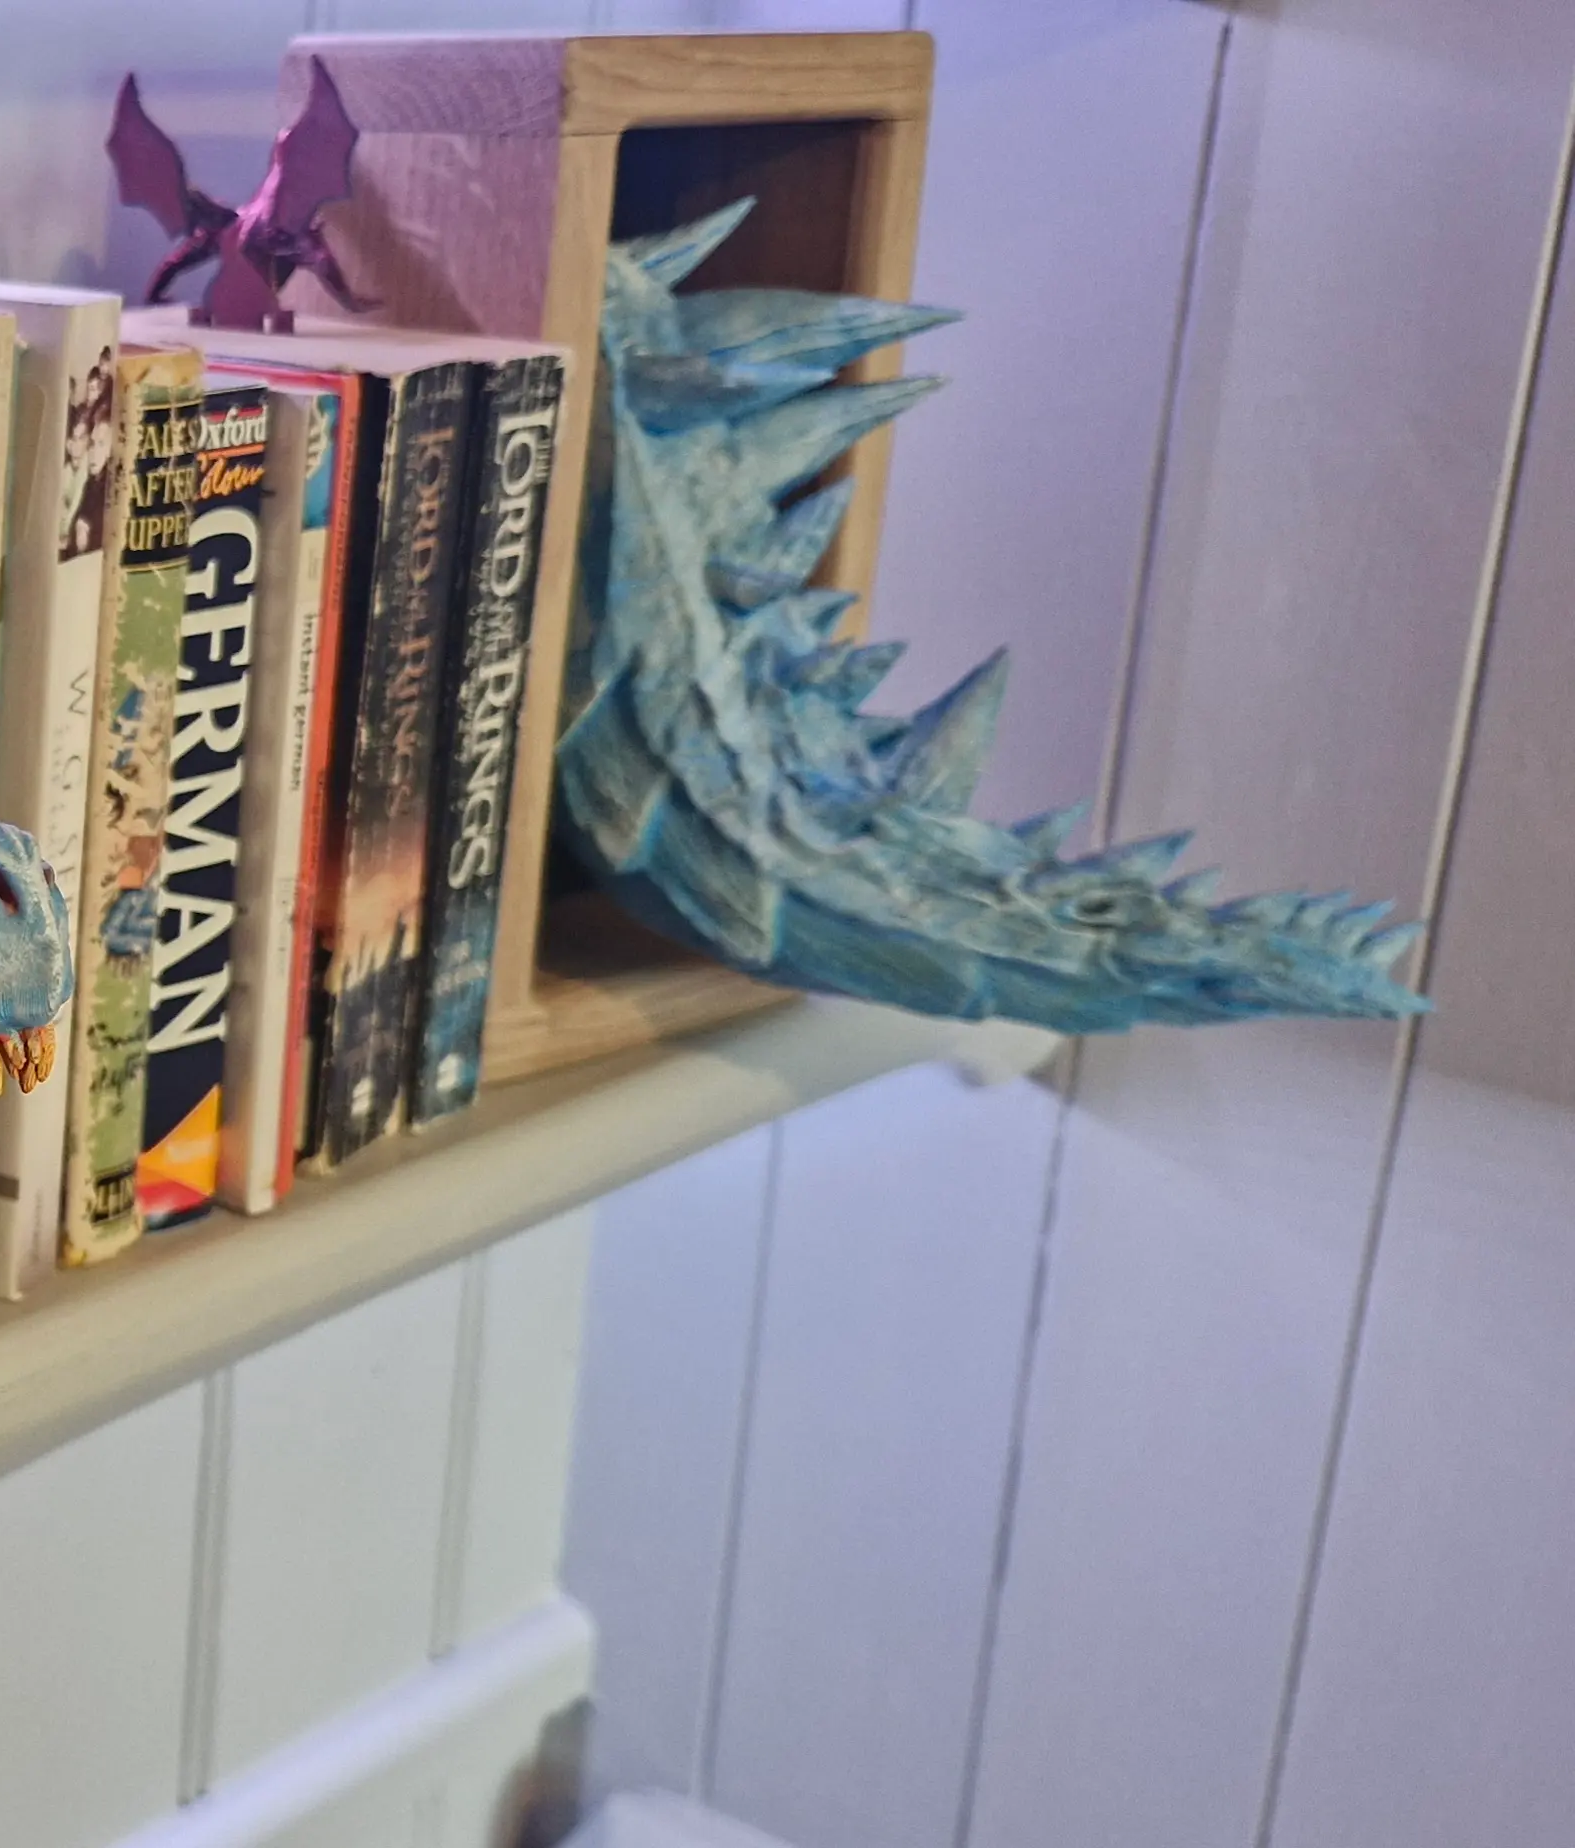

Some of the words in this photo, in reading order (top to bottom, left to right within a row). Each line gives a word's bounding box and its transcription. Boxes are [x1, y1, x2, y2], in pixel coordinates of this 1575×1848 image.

[125, 513, 189, 551] UPPE
[138, 420, 201, 459] ALES
[491, 406, 555, 598] LORD
[147, 507, 261, 1053] GERMAN
[447, 652, 525, 889] RINGS
